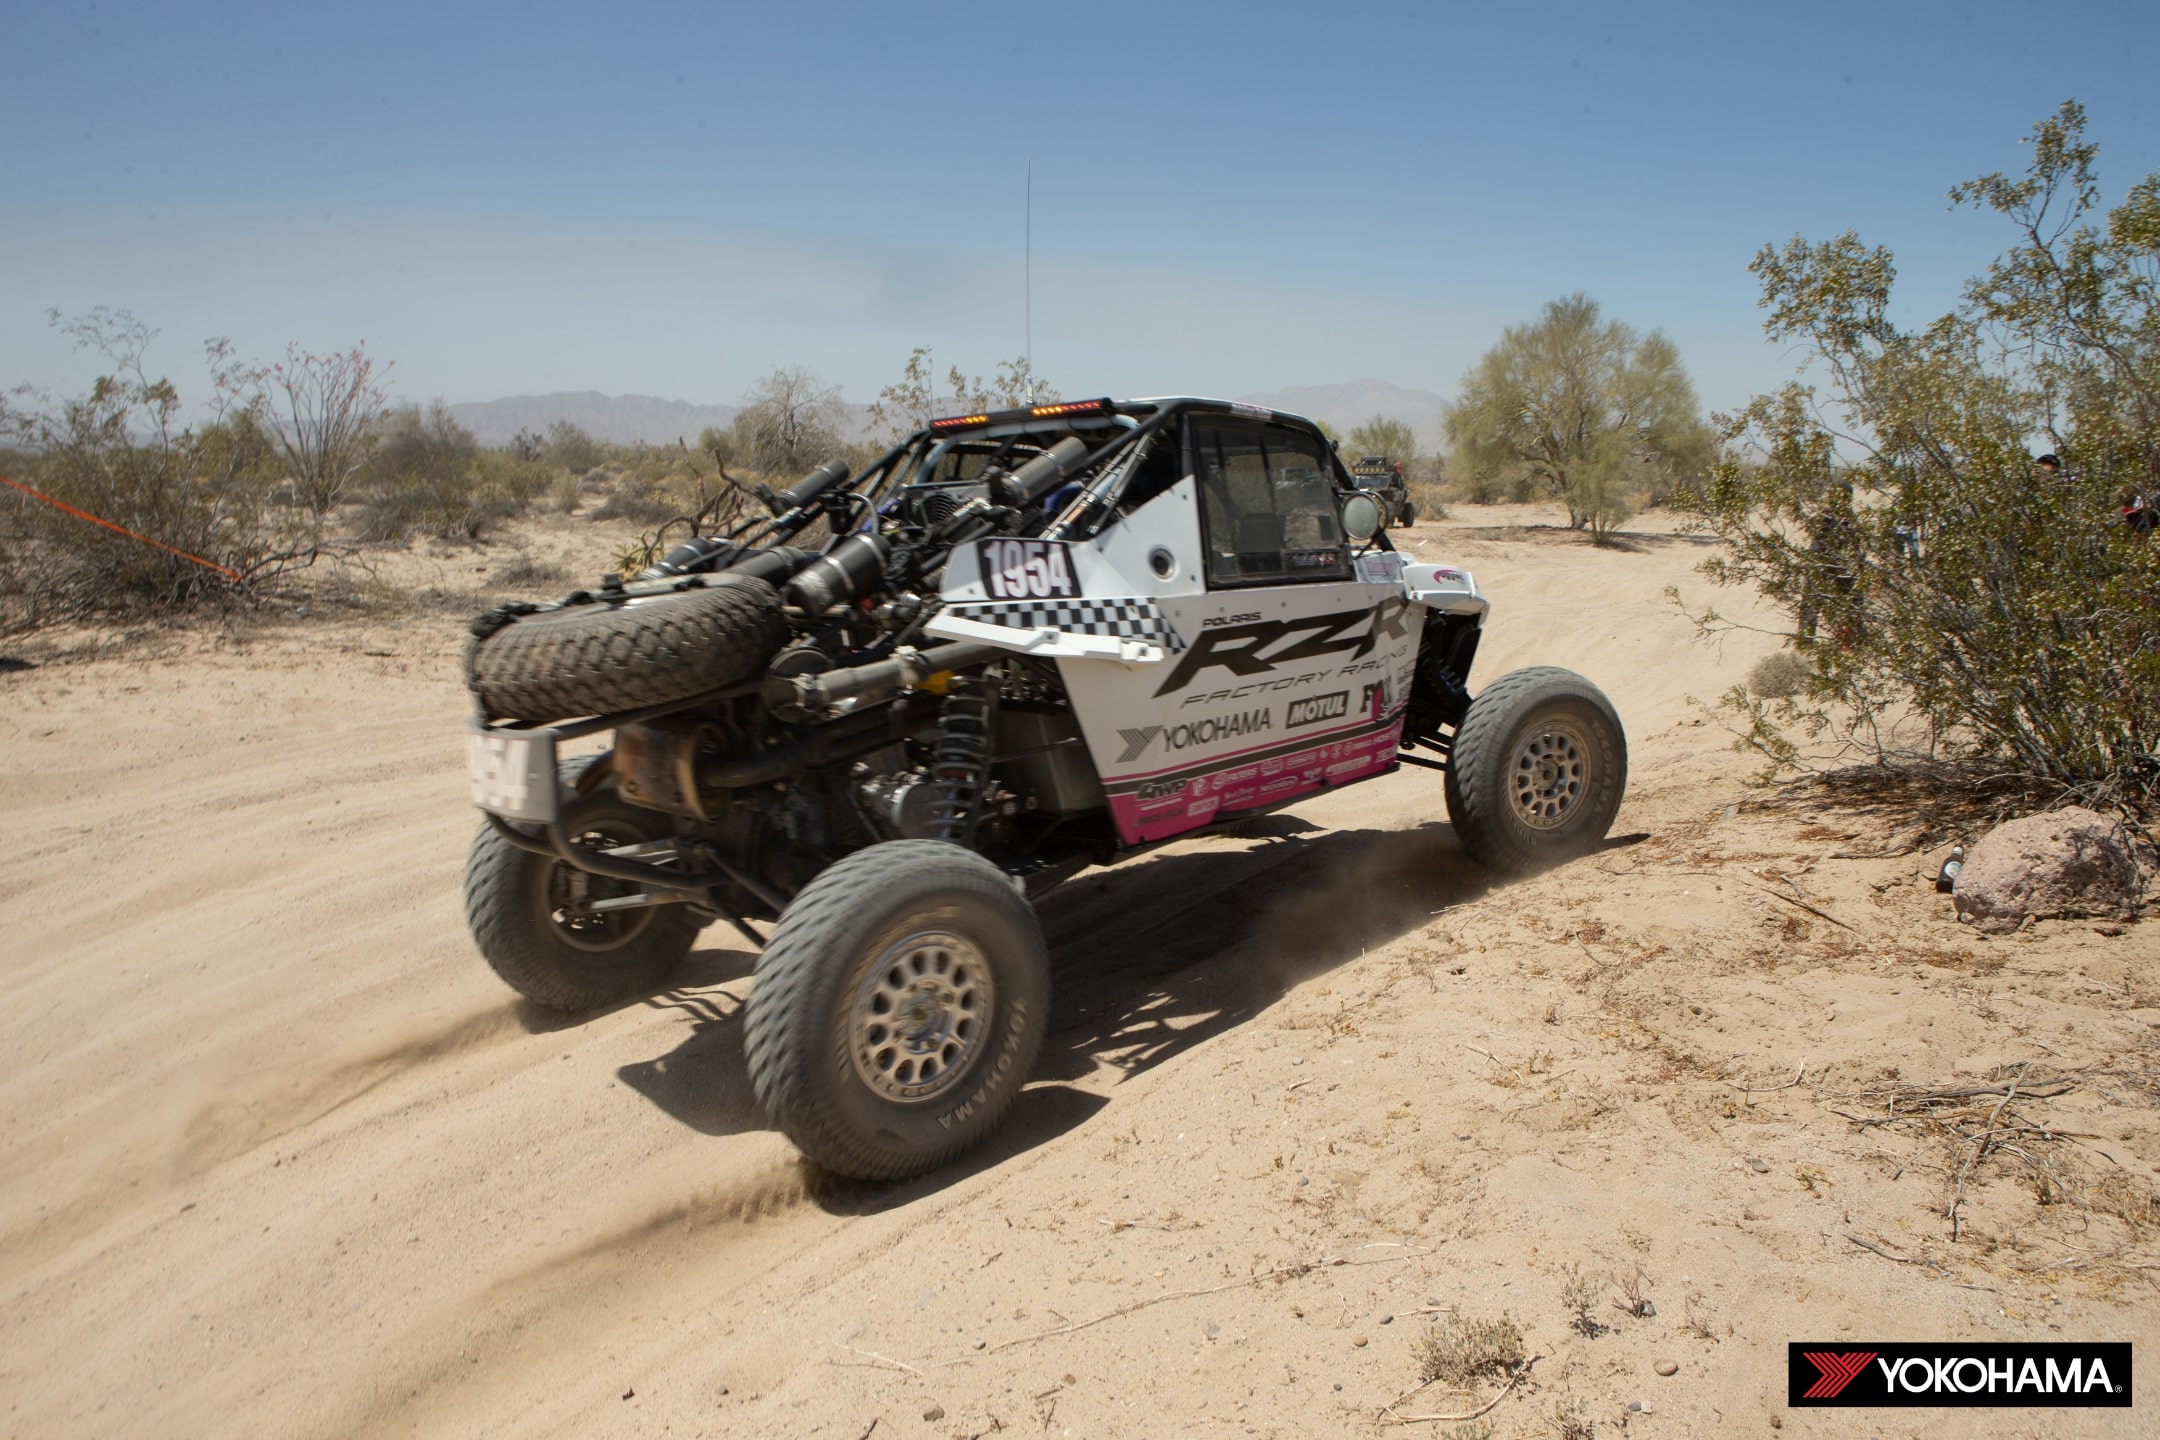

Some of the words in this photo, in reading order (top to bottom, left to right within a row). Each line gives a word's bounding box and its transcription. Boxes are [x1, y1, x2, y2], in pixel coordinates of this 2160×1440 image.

[984, 541, 1074, 598] 1954
[1153, 595, 1409, 698] RZR
[1202, 611, 1261, 628] POLARIS
[1180, 669, 1333, 708] FACTORY
[1338, 644, 1407, 678] RACING
[1163, 707, 1271, 752] YOKOHAMA
[1288, 692, 1346, 725] MOTUL
[936, 997, 1028, 1130] YOKOHAMA
